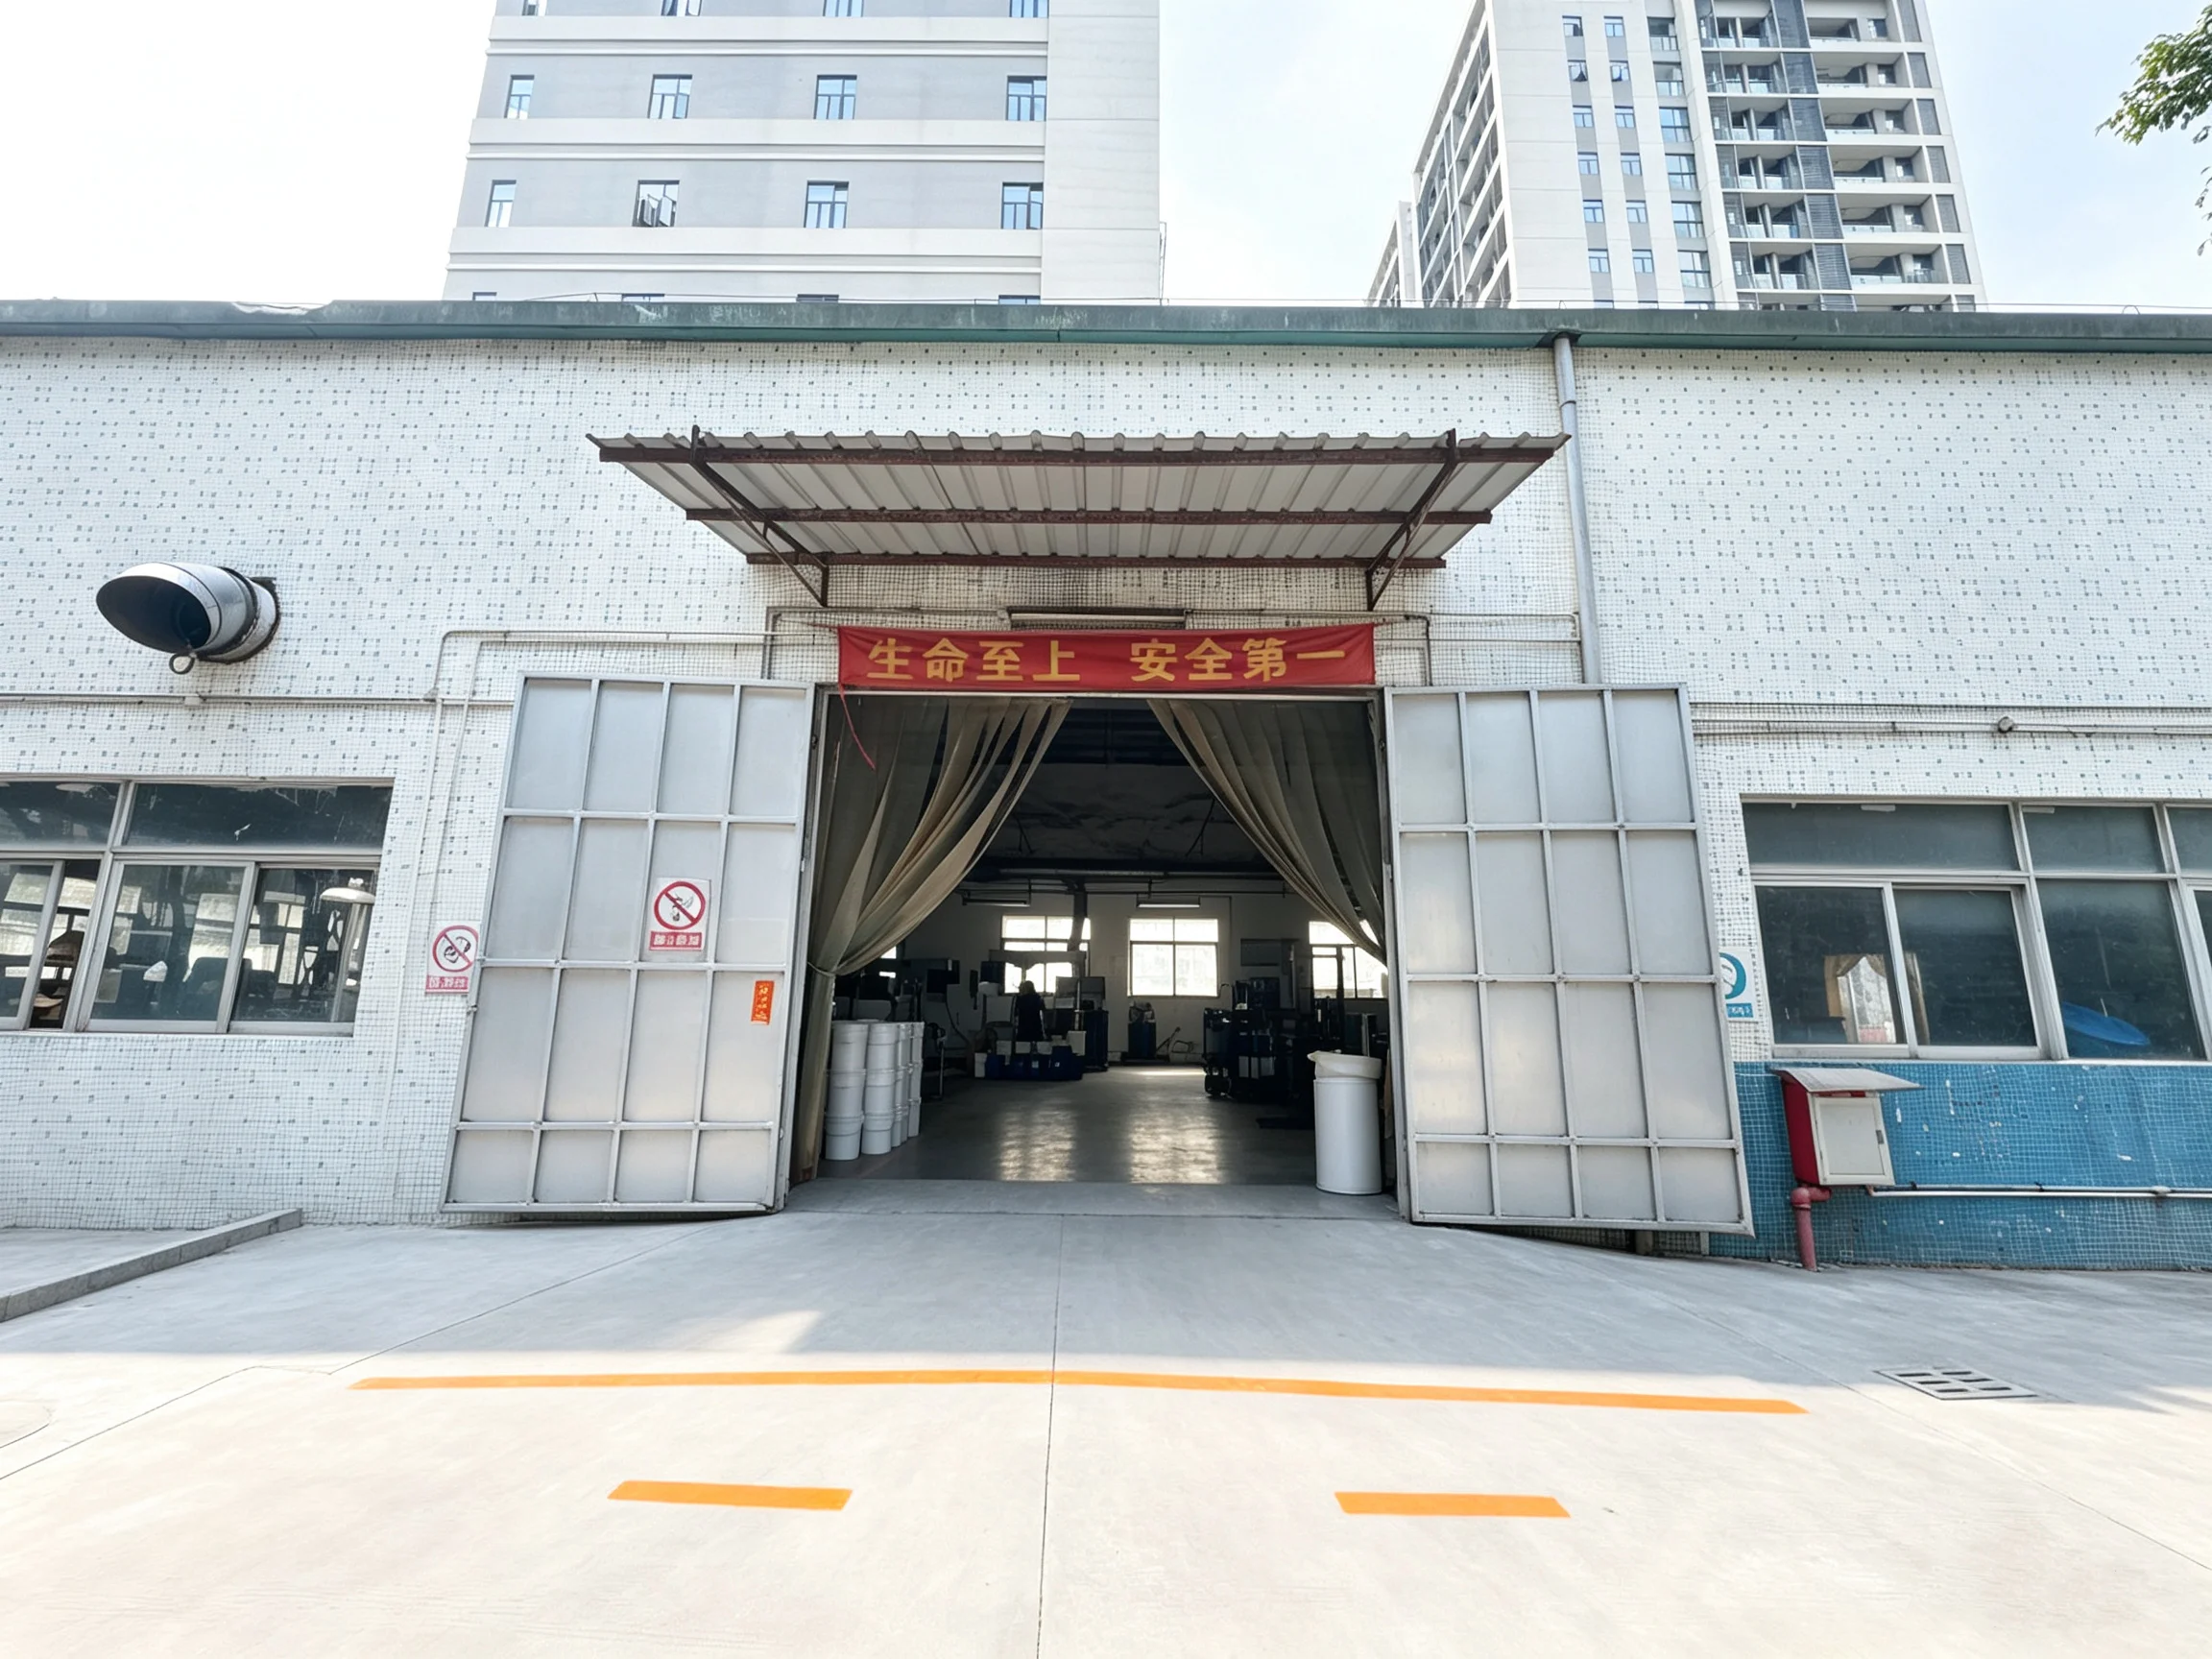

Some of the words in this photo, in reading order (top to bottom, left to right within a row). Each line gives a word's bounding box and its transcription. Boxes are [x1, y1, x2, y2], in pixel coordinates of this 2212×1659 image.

[867, 637, 1081, 683] 生命至上
[1129, 637, 1346, 682] 安全第一
